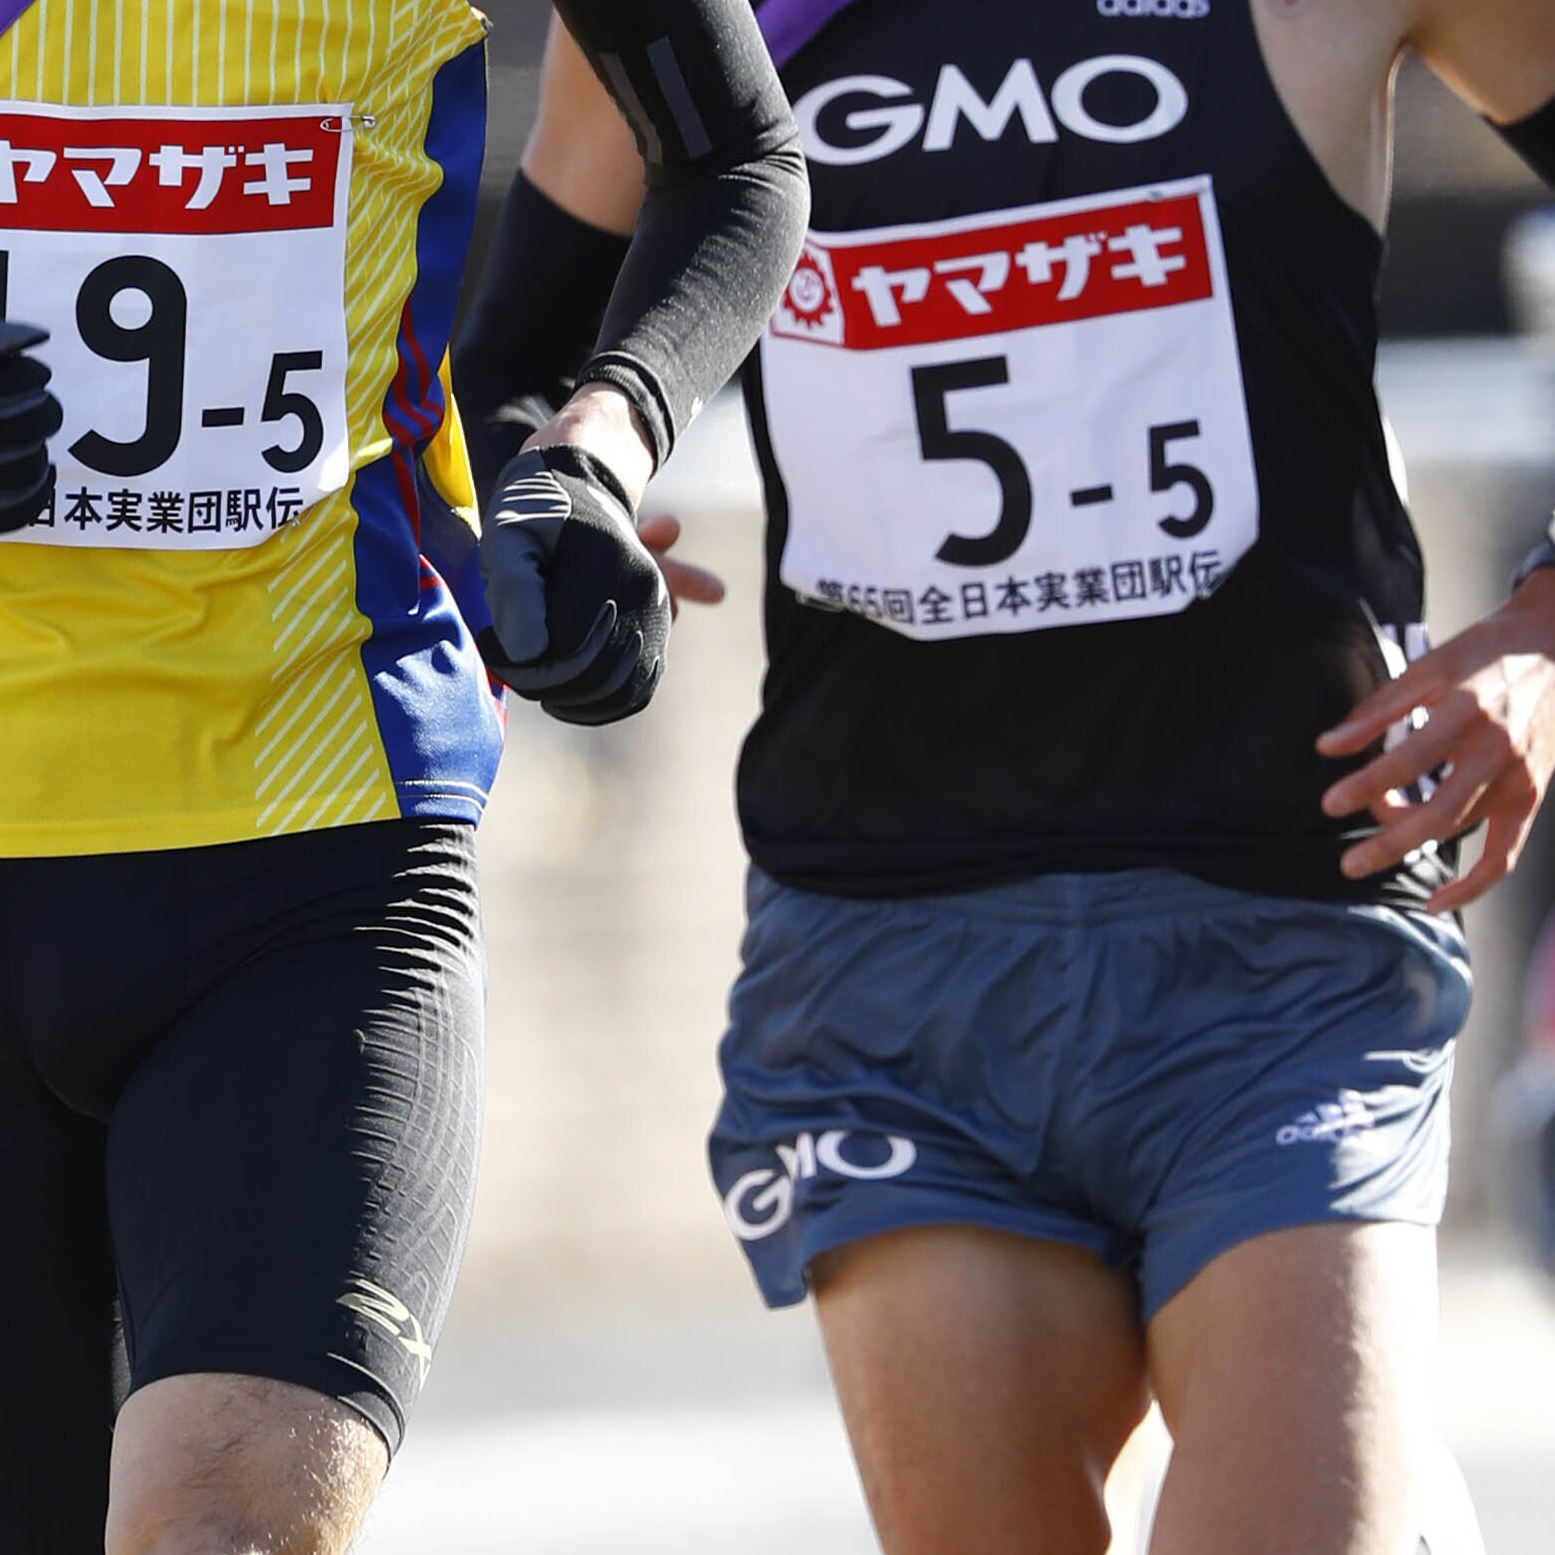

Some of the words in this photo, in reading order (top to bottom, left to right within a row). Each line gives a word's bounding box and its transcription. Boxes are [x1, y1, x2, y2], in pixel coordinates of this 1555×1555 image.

[792, 53, 1189, 166] GMO
[851, 223, 1187, 328] ヤマザキ
